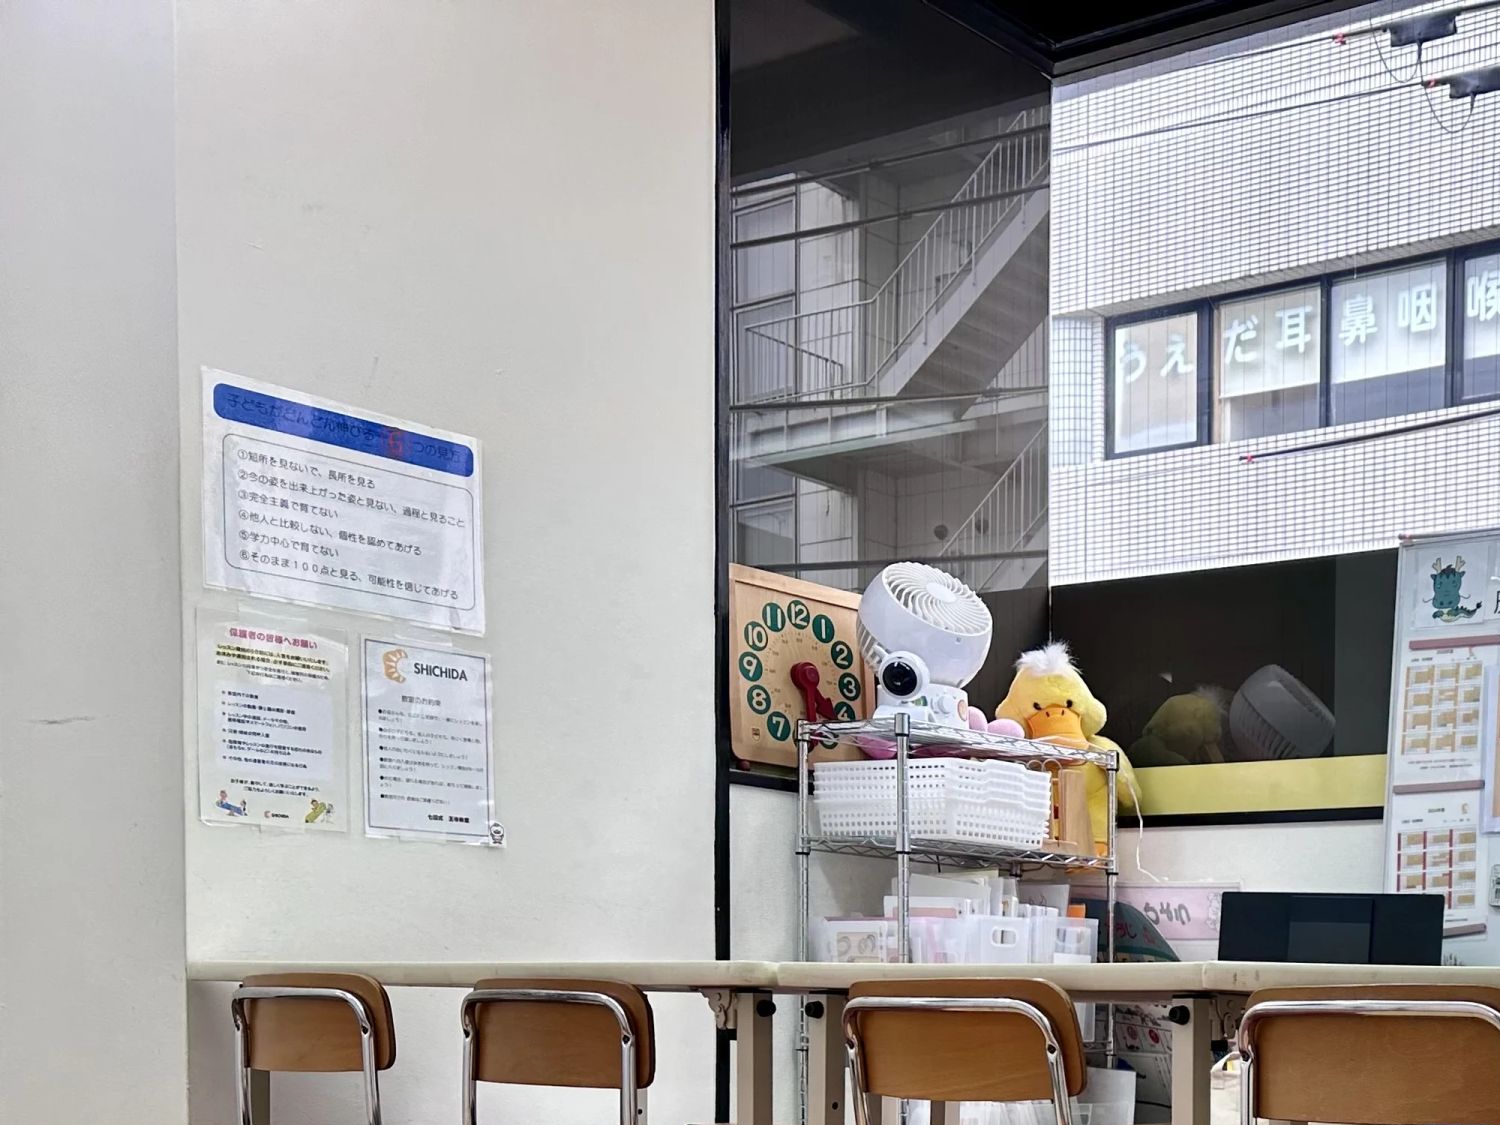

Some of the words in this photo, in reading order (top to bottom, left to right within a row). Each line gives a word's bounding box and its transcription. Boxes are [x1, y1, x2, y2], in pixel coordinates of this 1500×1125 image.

[766, 606, 781, 628] 11
[792, 603, 807, 625] 12
[748, 624, 767, 648] 10
[821, 619, 825, 639] 1
[836, 644, 849, 666] 2
[414, 663, 468, 681] SHICHIDA
[743, 658, 757, 678] 9
[843, 677, 856, 697] 3
[752, 689, 766, 712] 8
[772, 716, 785, 738] 7
